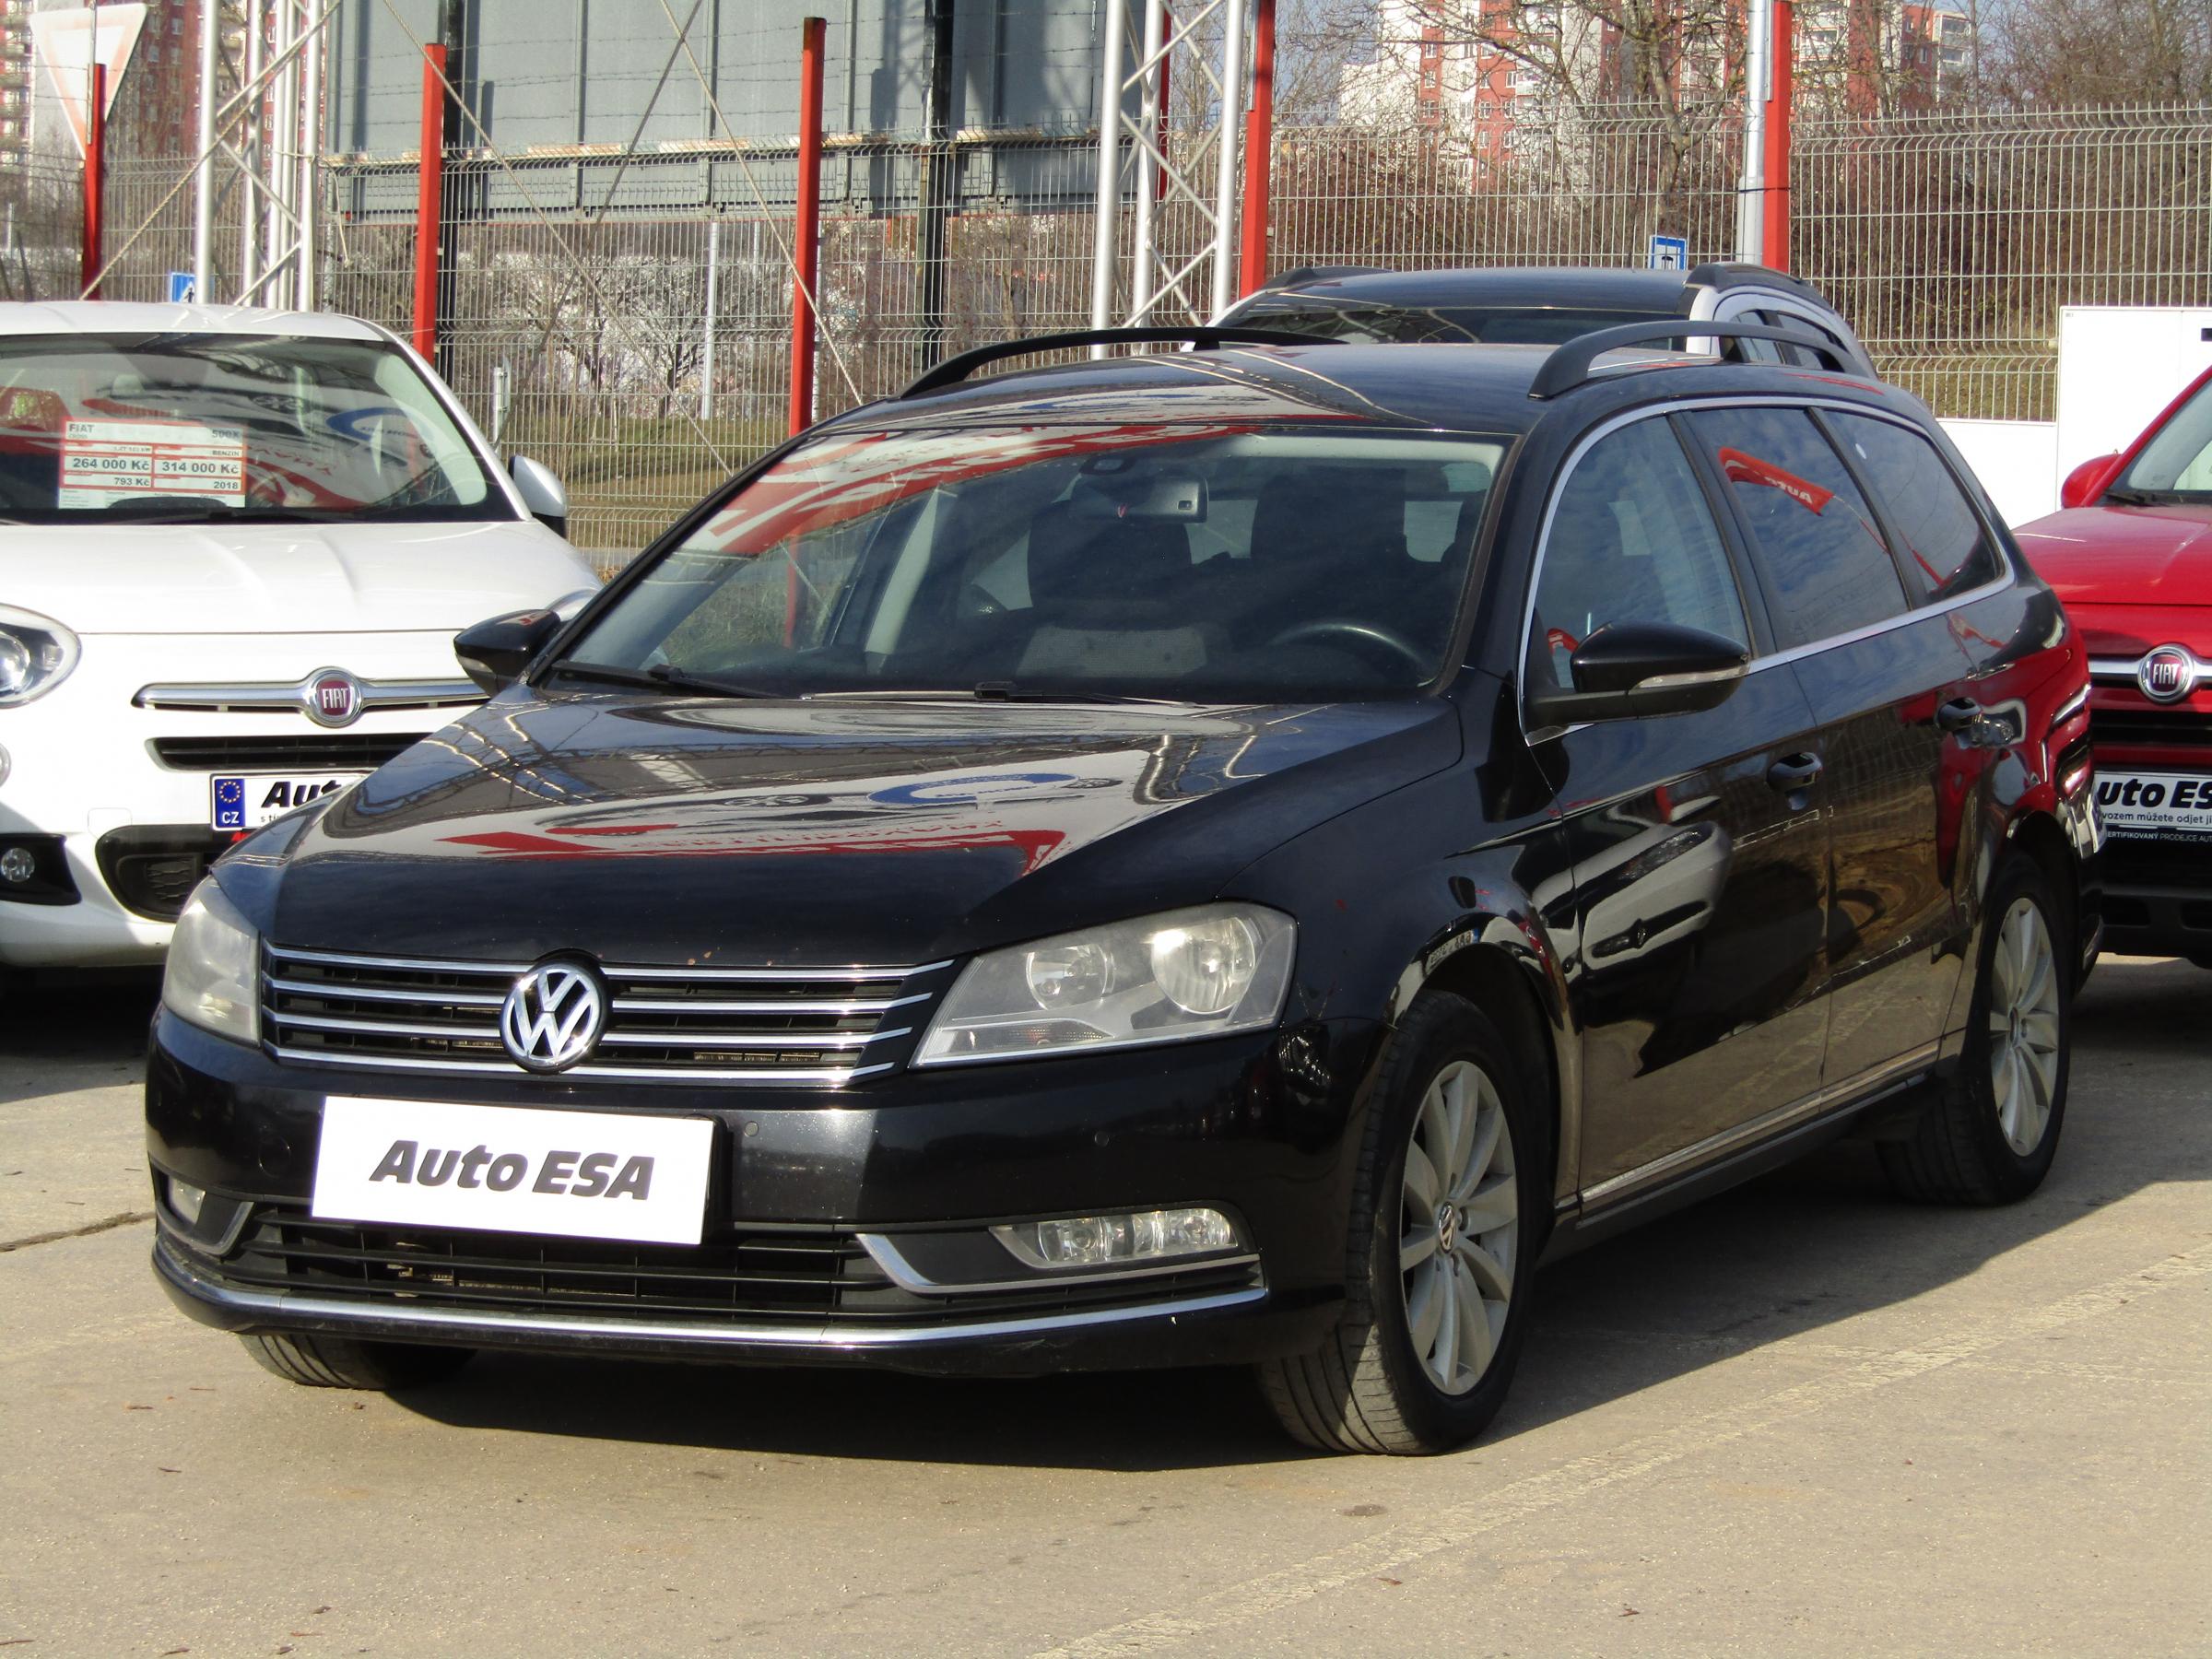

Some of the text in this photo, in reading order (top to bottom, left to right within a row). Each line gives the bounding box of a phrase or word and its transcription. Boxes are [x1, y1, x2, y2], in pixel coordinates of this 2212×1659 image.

[69, 423, 94, 432] FIAT
[73, 458, 150, 470] 264 000 Kč
[162, 461, 239, 474] 314 000 Kč
[114, 477, 150, 487] 793 Kč
[214, 481, 238, 489] 2018
[2153, 663, 2180, 684] FIAT
[323, 688, 348, 708] FIAT
[261, 780, 342, 807] Aut
[2098, 779, 2212, 809] uto ES
[221, 811, 240, 824] CZ
[2102, 812, 2134, 820] vozem
[2137, 812, 2173, 822] můžete
[2177, 815, 2204, 825] odjet
[2107, 830, 2159, 840] ERTIFIKOVANÝ
[369, 1139, 655, 1200] Auto ESA
